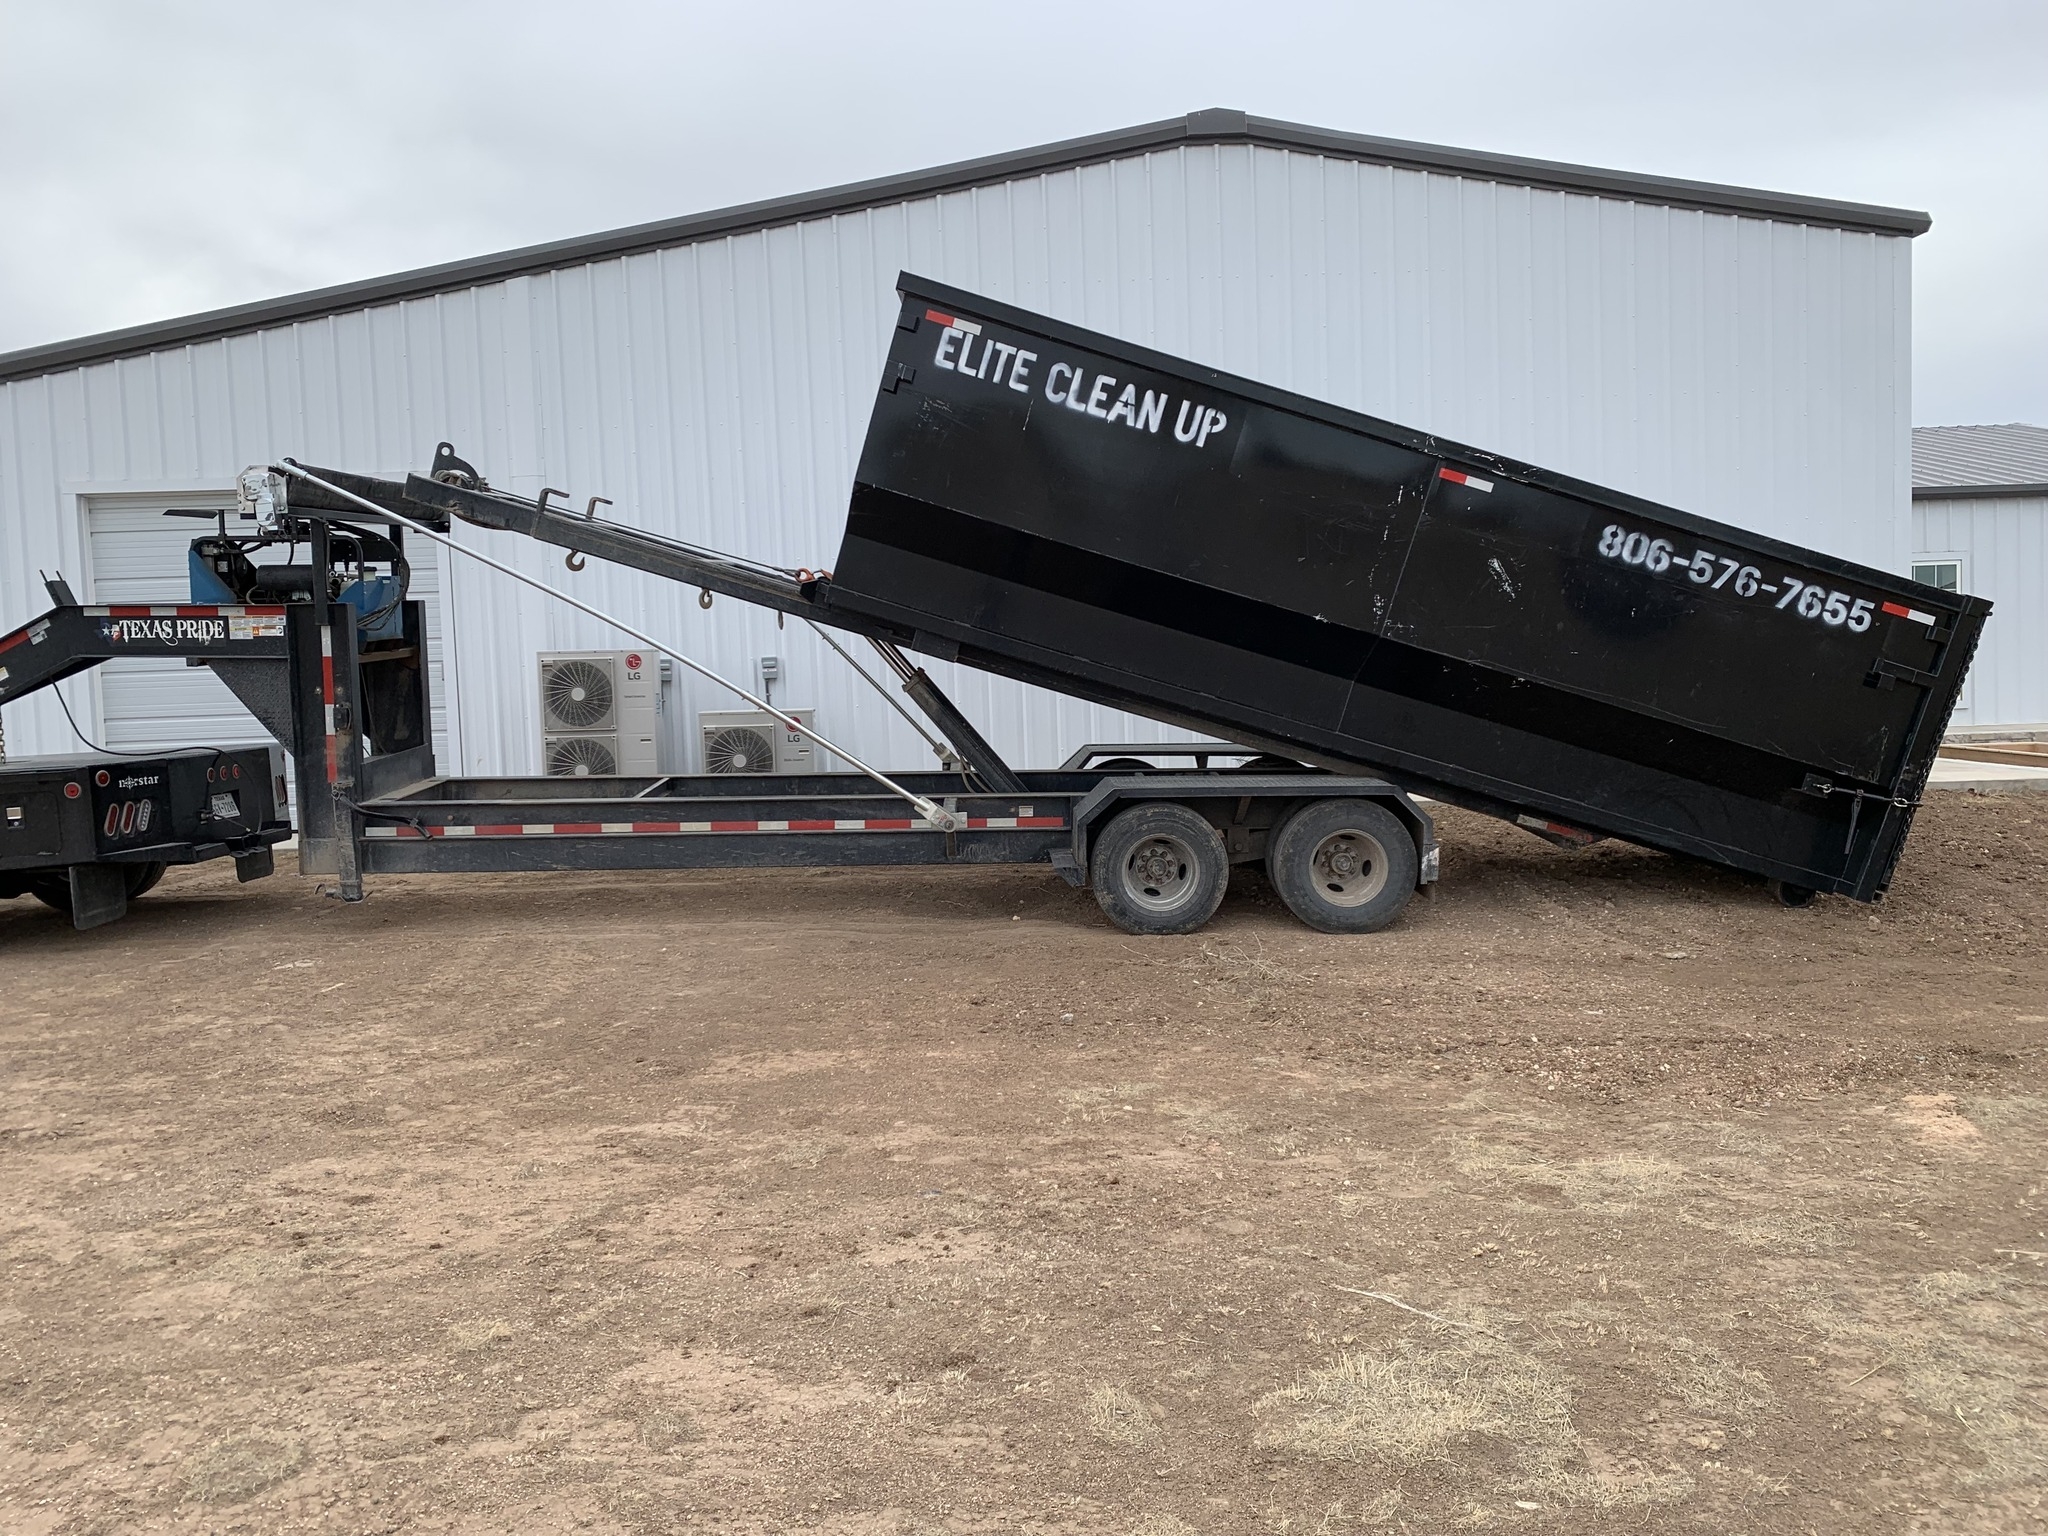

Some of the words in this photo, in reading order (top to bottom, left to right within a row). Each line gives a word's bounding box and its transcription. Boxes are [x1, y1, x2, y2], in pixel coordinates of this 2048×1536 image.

[934, 326, 1038, 393] ELITE
[1044, 362, 1169, 434] CLEAN
[1174, 400, 1228, 448] UP
[1599, 524, 1876, 632] 806-576-7655
[119, 619, 178, 646] TEXAS
[176, 619, 225, 646] PRIDE
[627, 672, 641, 680] LG
[787, 734, 800, 743] LG
